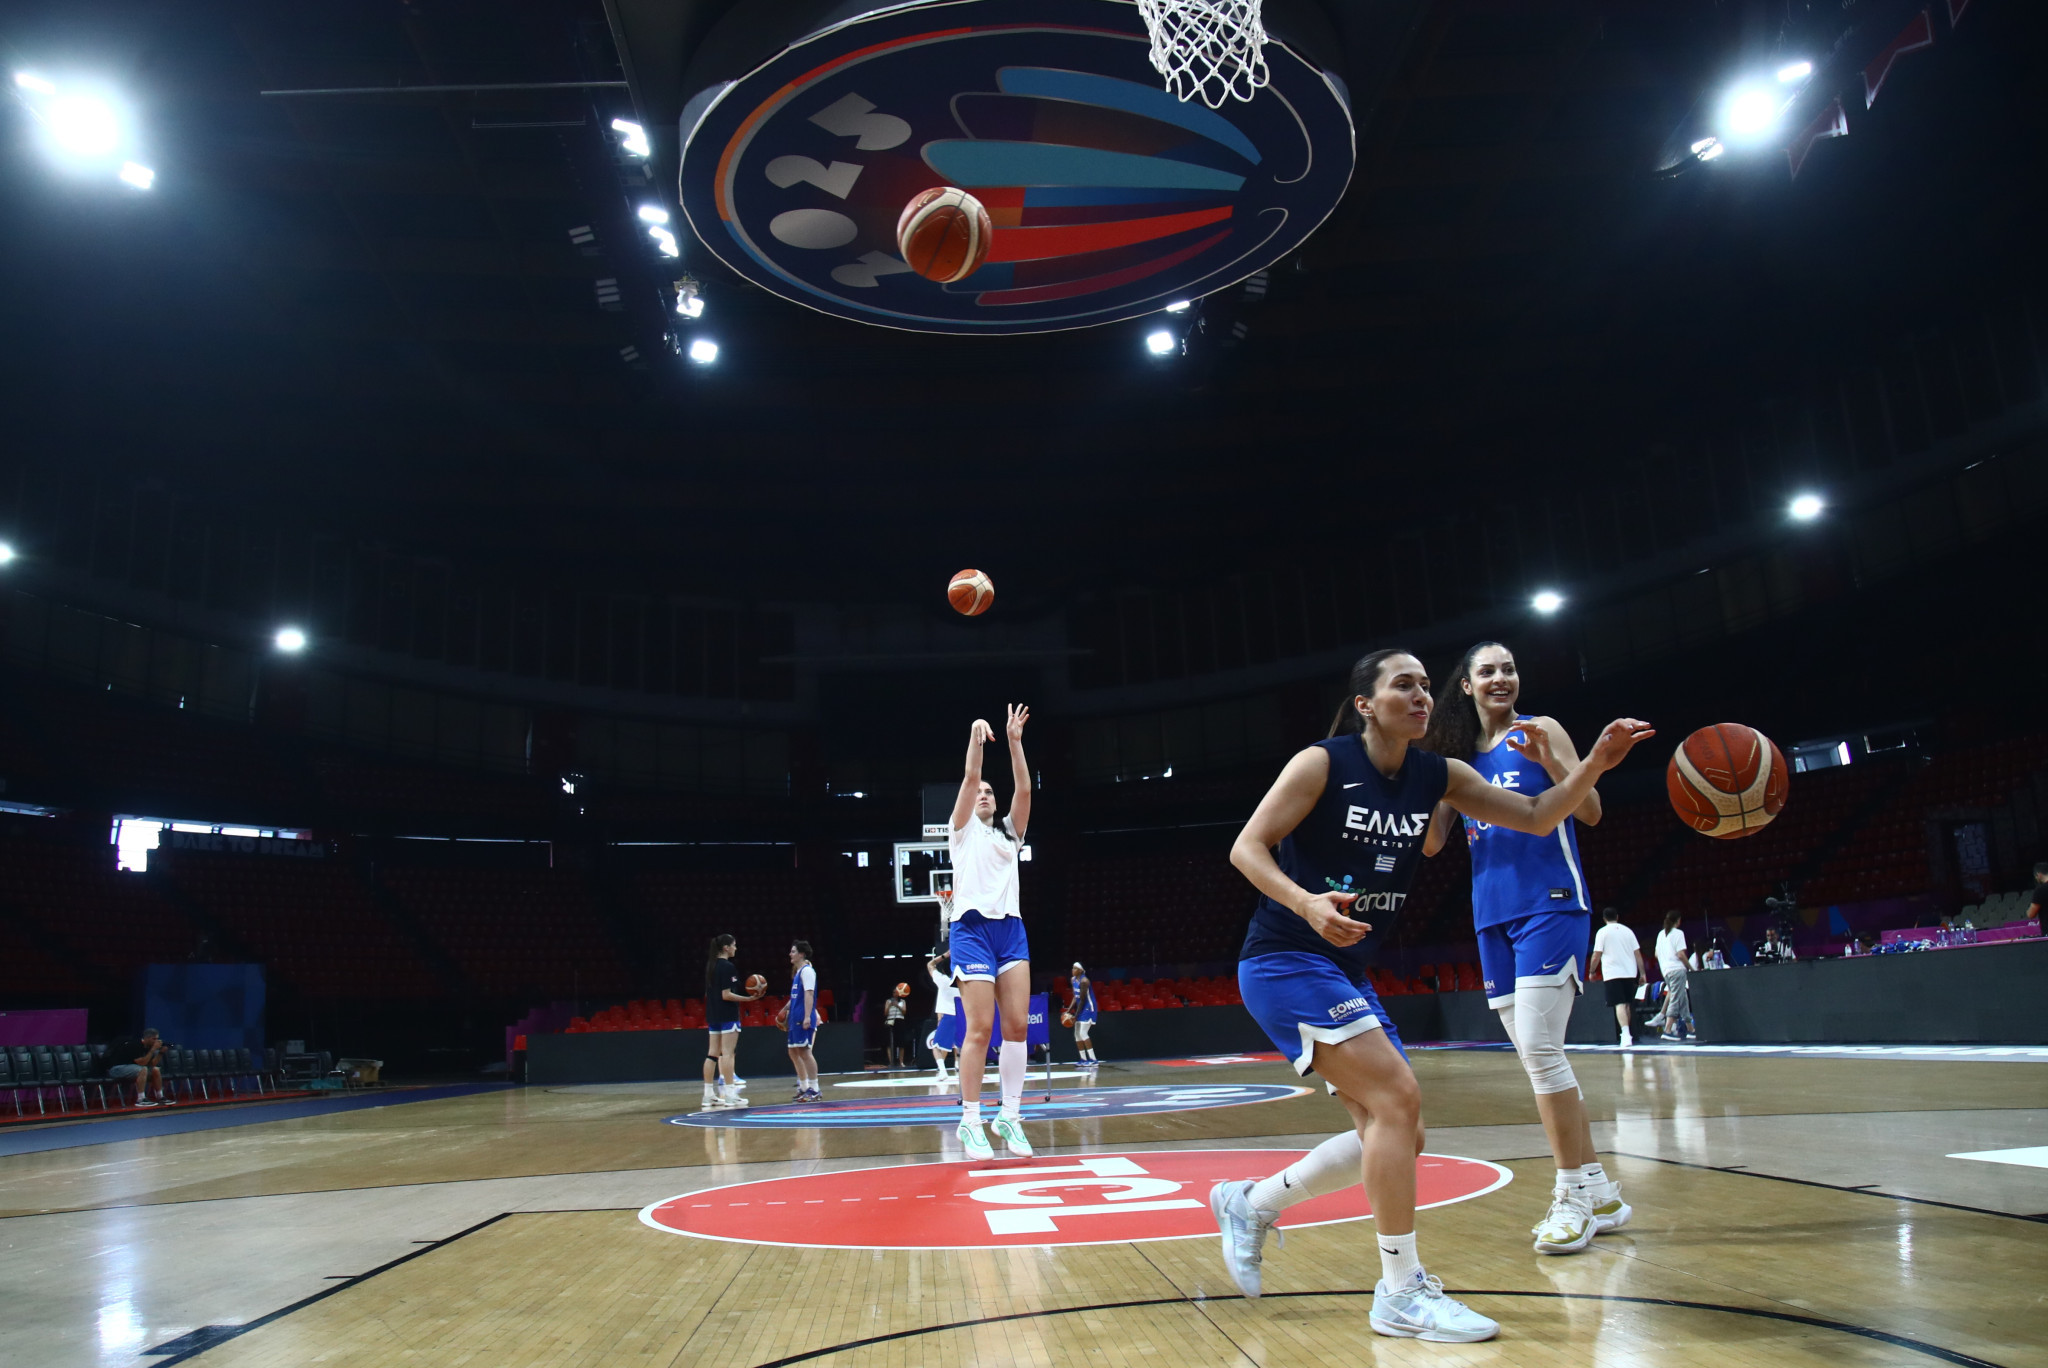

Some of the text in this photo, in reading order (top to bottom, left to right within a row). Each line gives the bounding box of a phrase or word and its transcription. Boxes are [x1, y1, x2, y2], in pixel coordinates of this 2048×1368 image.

[764, 91, 913, 288] 2025
[228, 837, 256, 853] TO
[259, 838, 325, 858] DREAM
[1341, 832, 1414, 849] BASKETB
[1027, 1013, 1043, 1024] ten
[967, 1156, 1206, 1236] TCL
